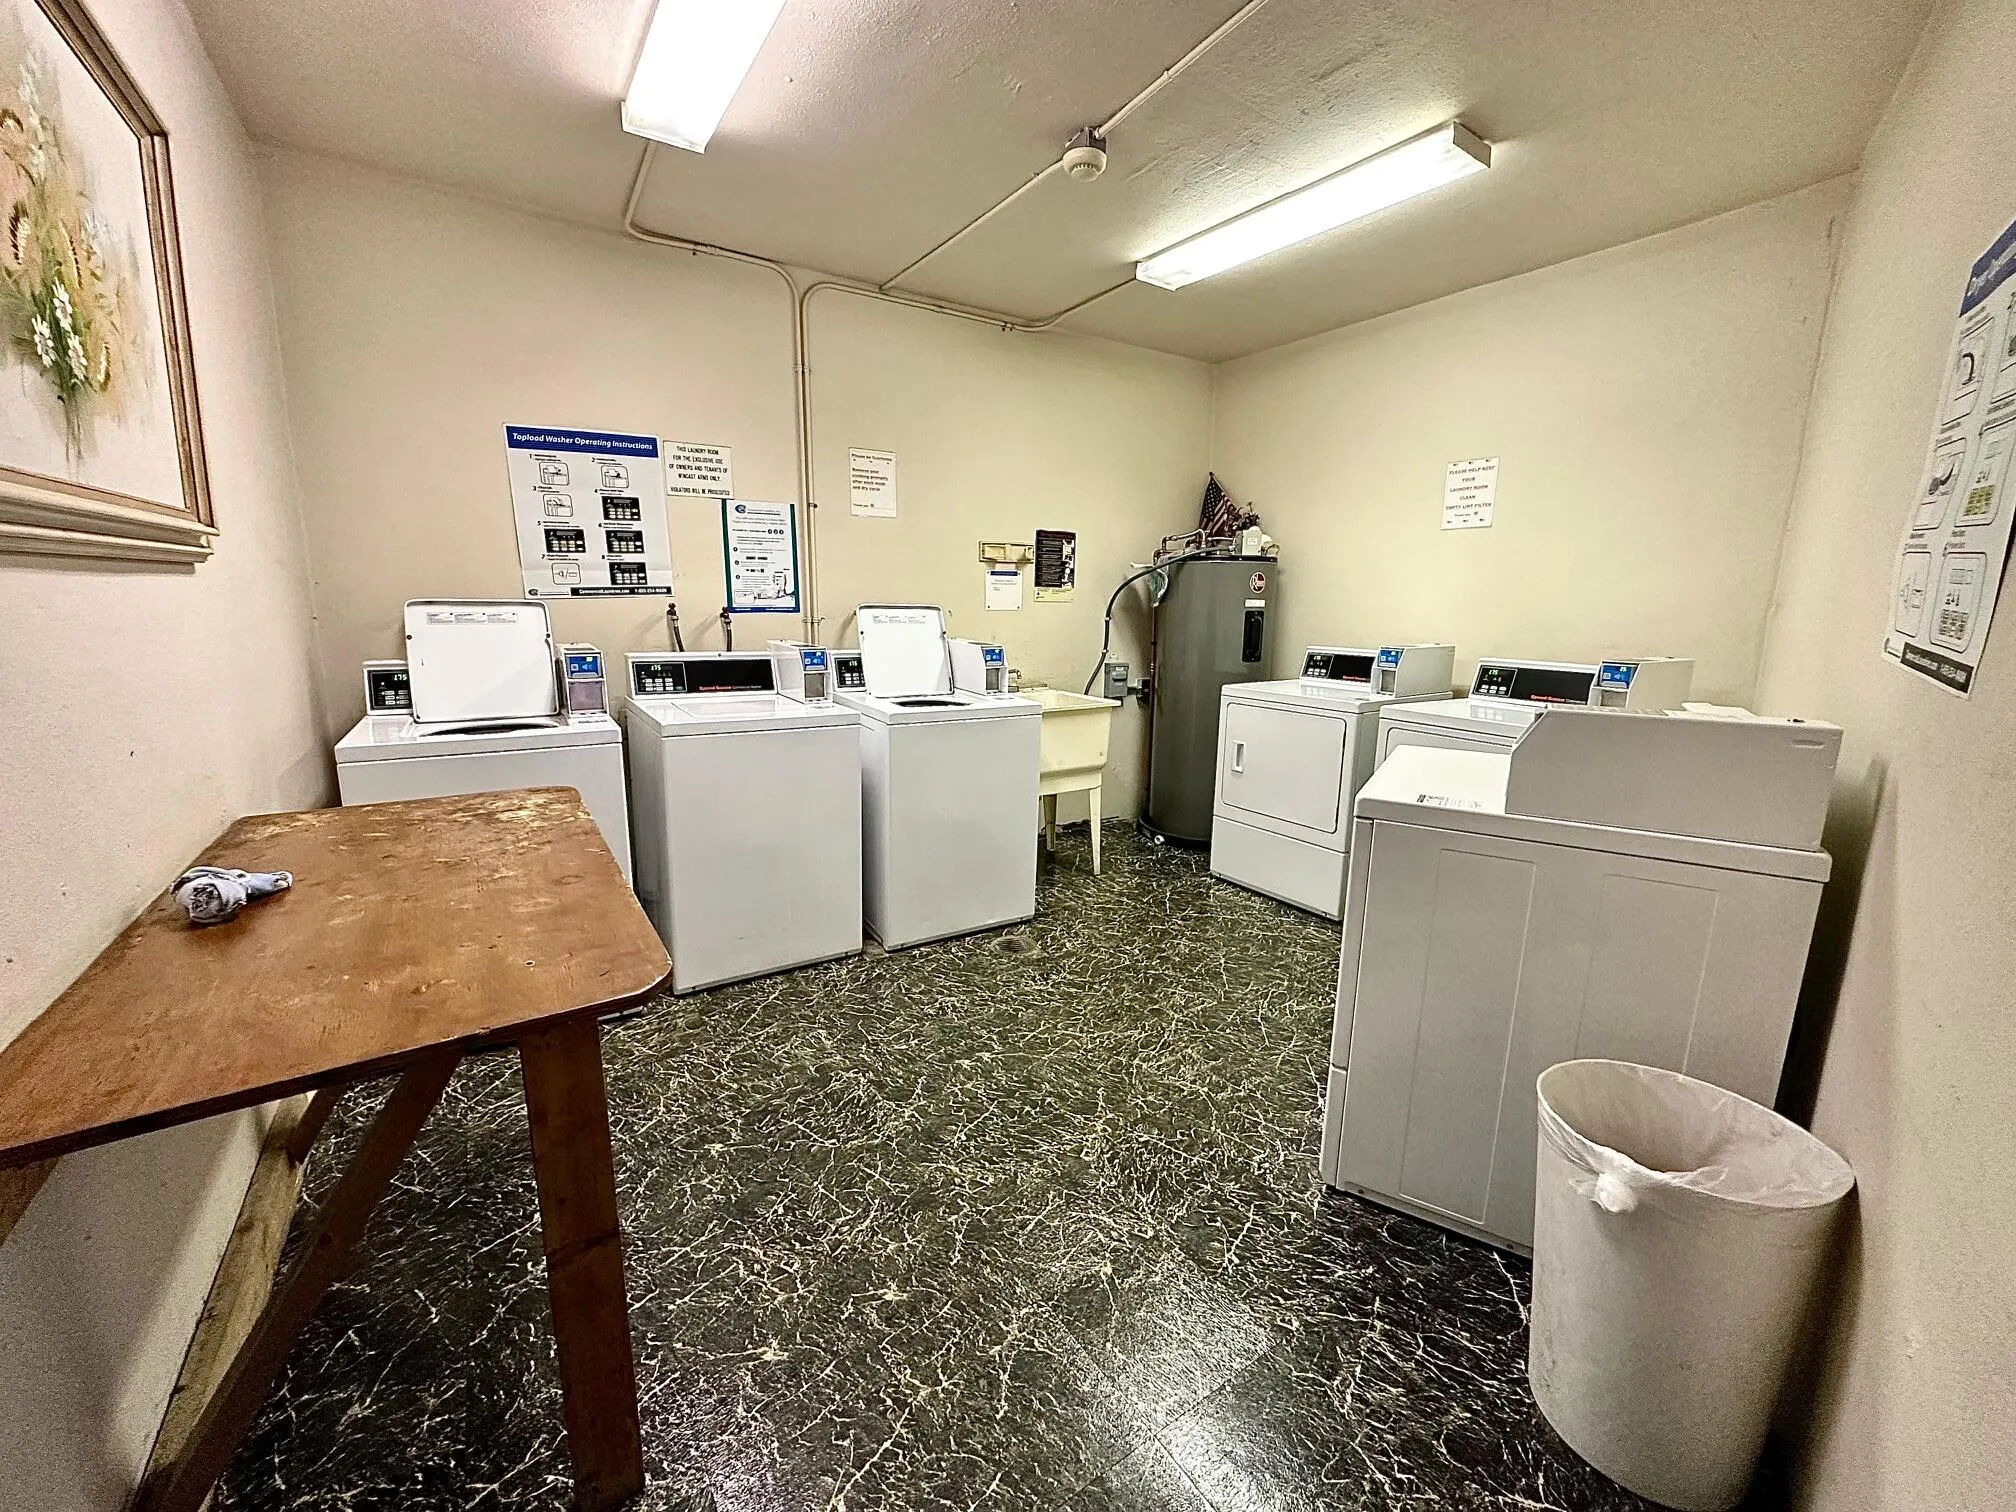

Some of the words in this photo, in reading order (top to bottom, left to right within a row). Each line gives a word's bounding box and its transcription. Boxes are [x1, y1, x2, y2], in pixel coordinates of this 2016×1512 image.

[512, 432, 544, 442] Topload
[546, 435, 573, 444] Washer
[574, 438, 611, 448] Operating
[612, 440, 652, 450] Instructions
